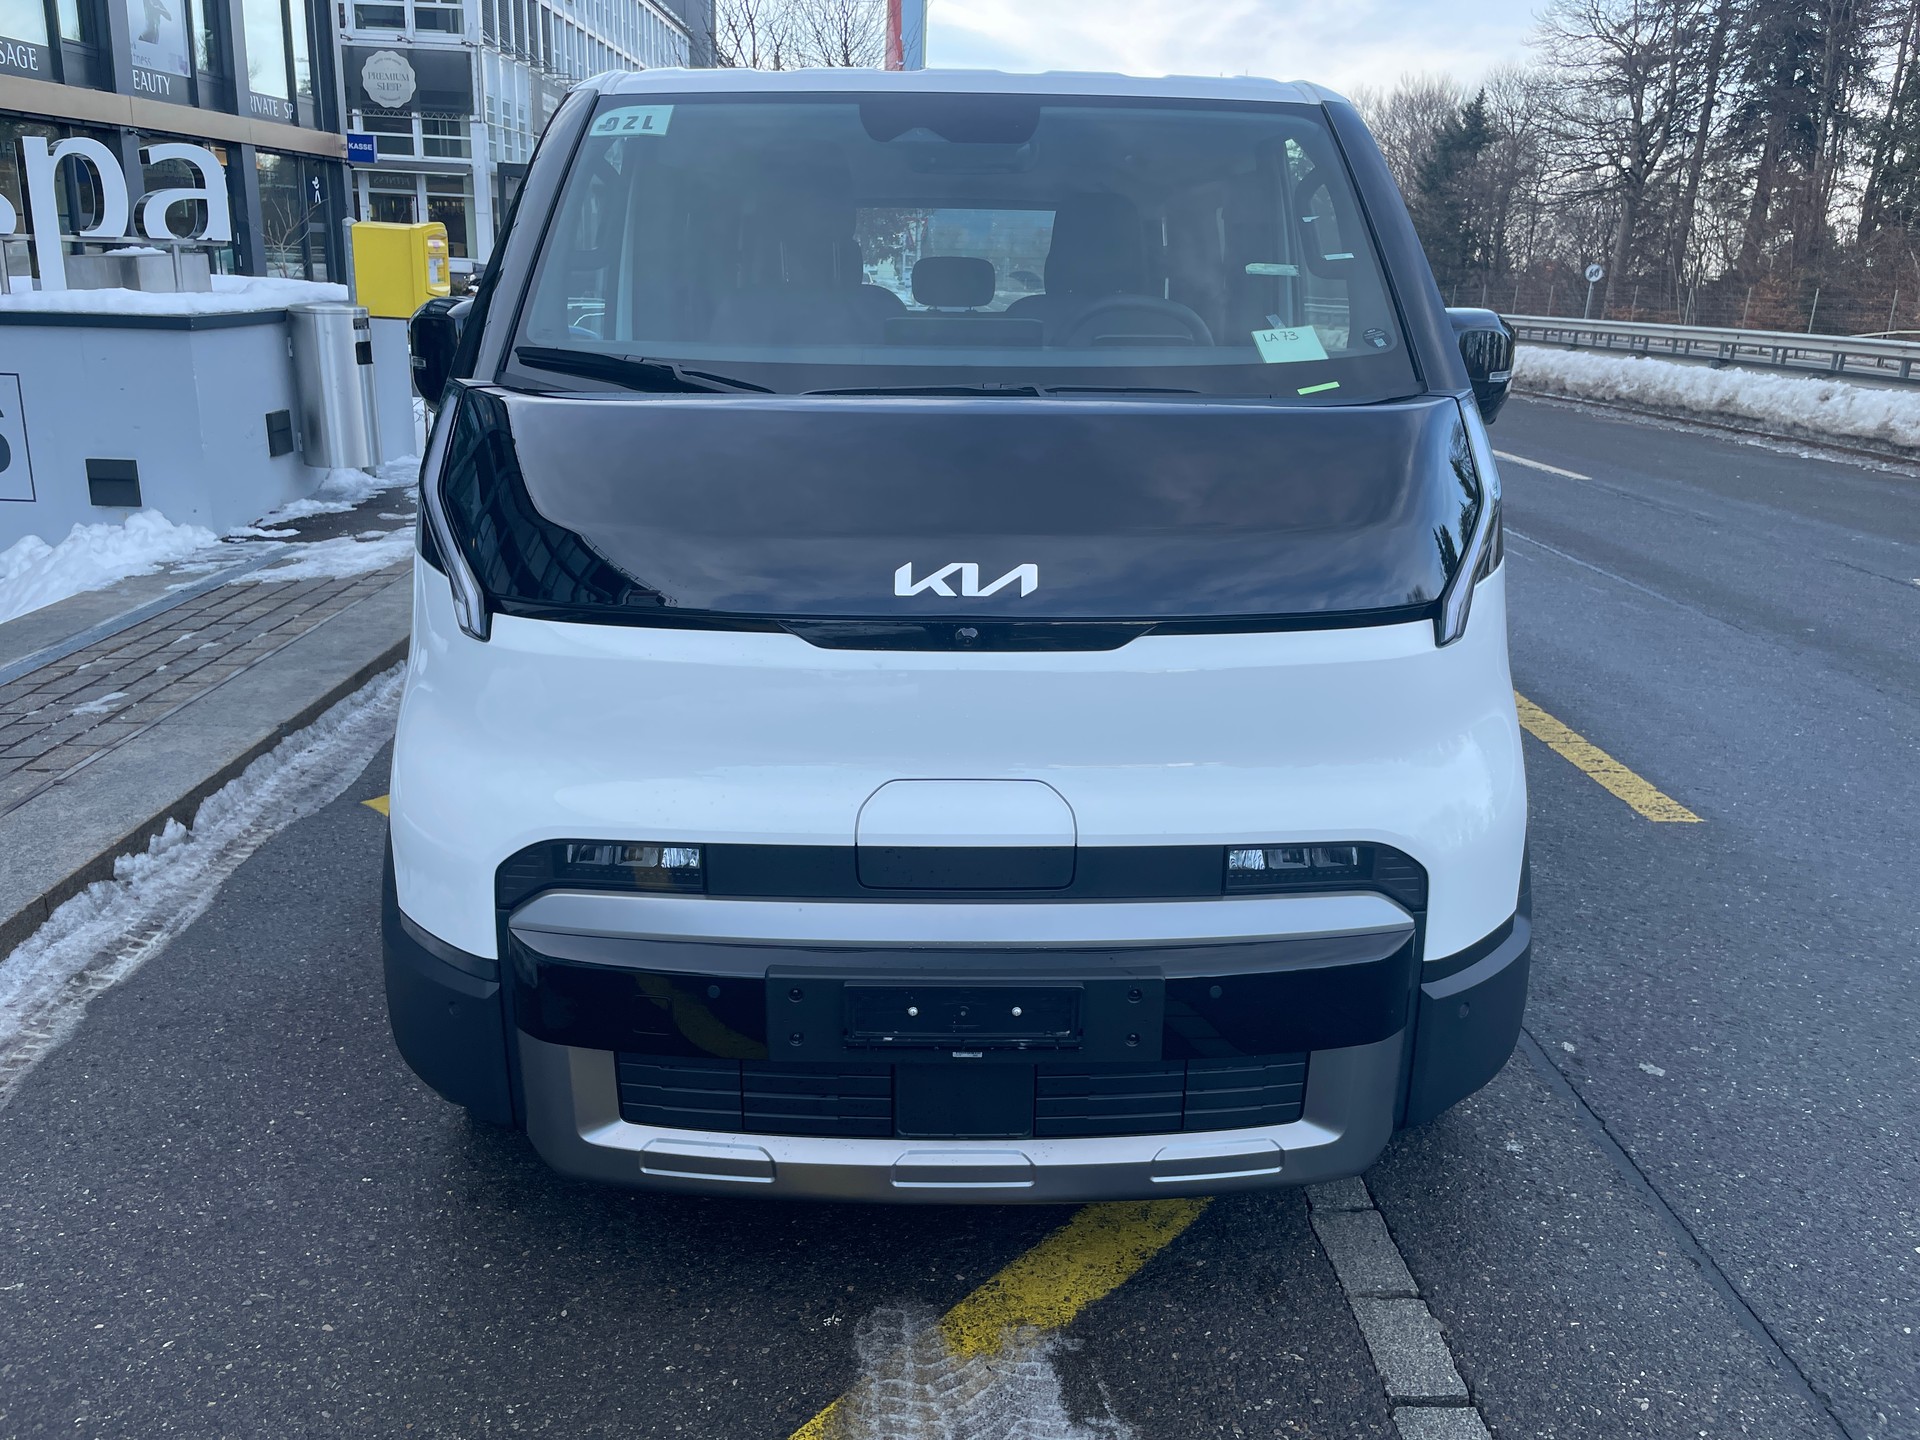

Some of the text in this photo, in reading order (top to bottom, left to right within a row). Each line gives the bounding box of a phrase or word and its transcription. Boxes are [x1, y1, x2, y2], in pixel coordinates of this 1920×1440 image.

[132, 69, 171, 95] EAUTY
[367, 71, 410, 82] PREMIUM
[348, 142, 373, 151] KASSE
[1588, 268, 1600, 278] 60
[1262, 330, 1299, 343] LA 73
[894, 561, 1038, 598] KIA
